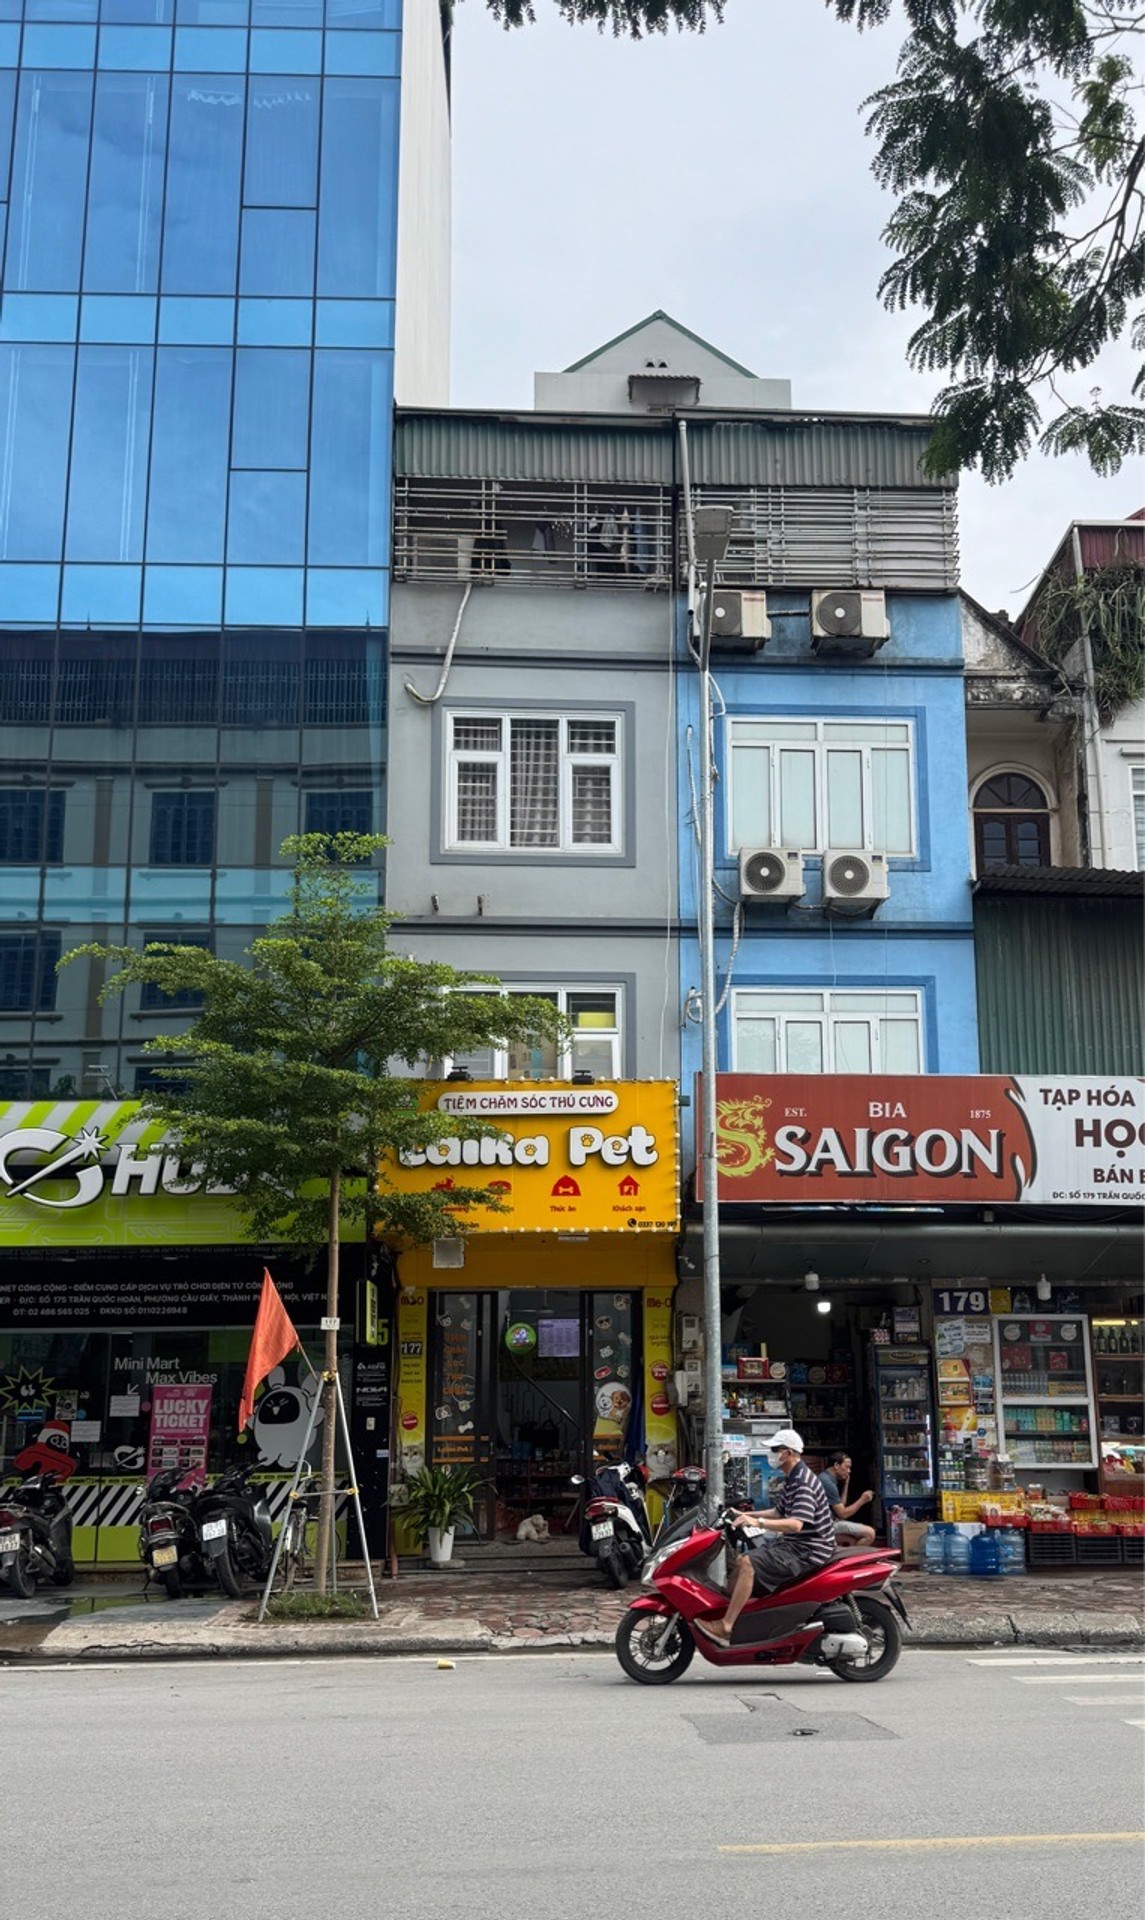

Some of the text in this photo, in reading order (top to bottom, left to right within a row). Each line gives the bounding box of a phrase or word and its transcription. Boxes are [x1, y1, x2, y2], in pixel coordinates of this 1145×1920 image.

[444, 1094, 614, 1112] TIỆM CHĂM SÓC THÚ CƯNG
[1040, 1085, 1136, 1111] TẠP HÓA
[784, 1102, 992, 1119] EST. BIA 1875
[568, 1125, 659, 1167] Pet
[1075, 1118, 1145, 1158] HỌ
[774, 1125, 1004, 1176] SAIGON
[1093, 1164, 1134, 1184] BÁN
[1069, 1189, 1081, 1200] SỐ
[938, 1291, 985, 1313] 179
[114, 1356, 180, 1370] Mini Mart
[145, 1371, 218, 1384] Max Vibes
[154, 1399, 208, 1414] LUCKY
[154, 1415, 206, 1428] TICKET
